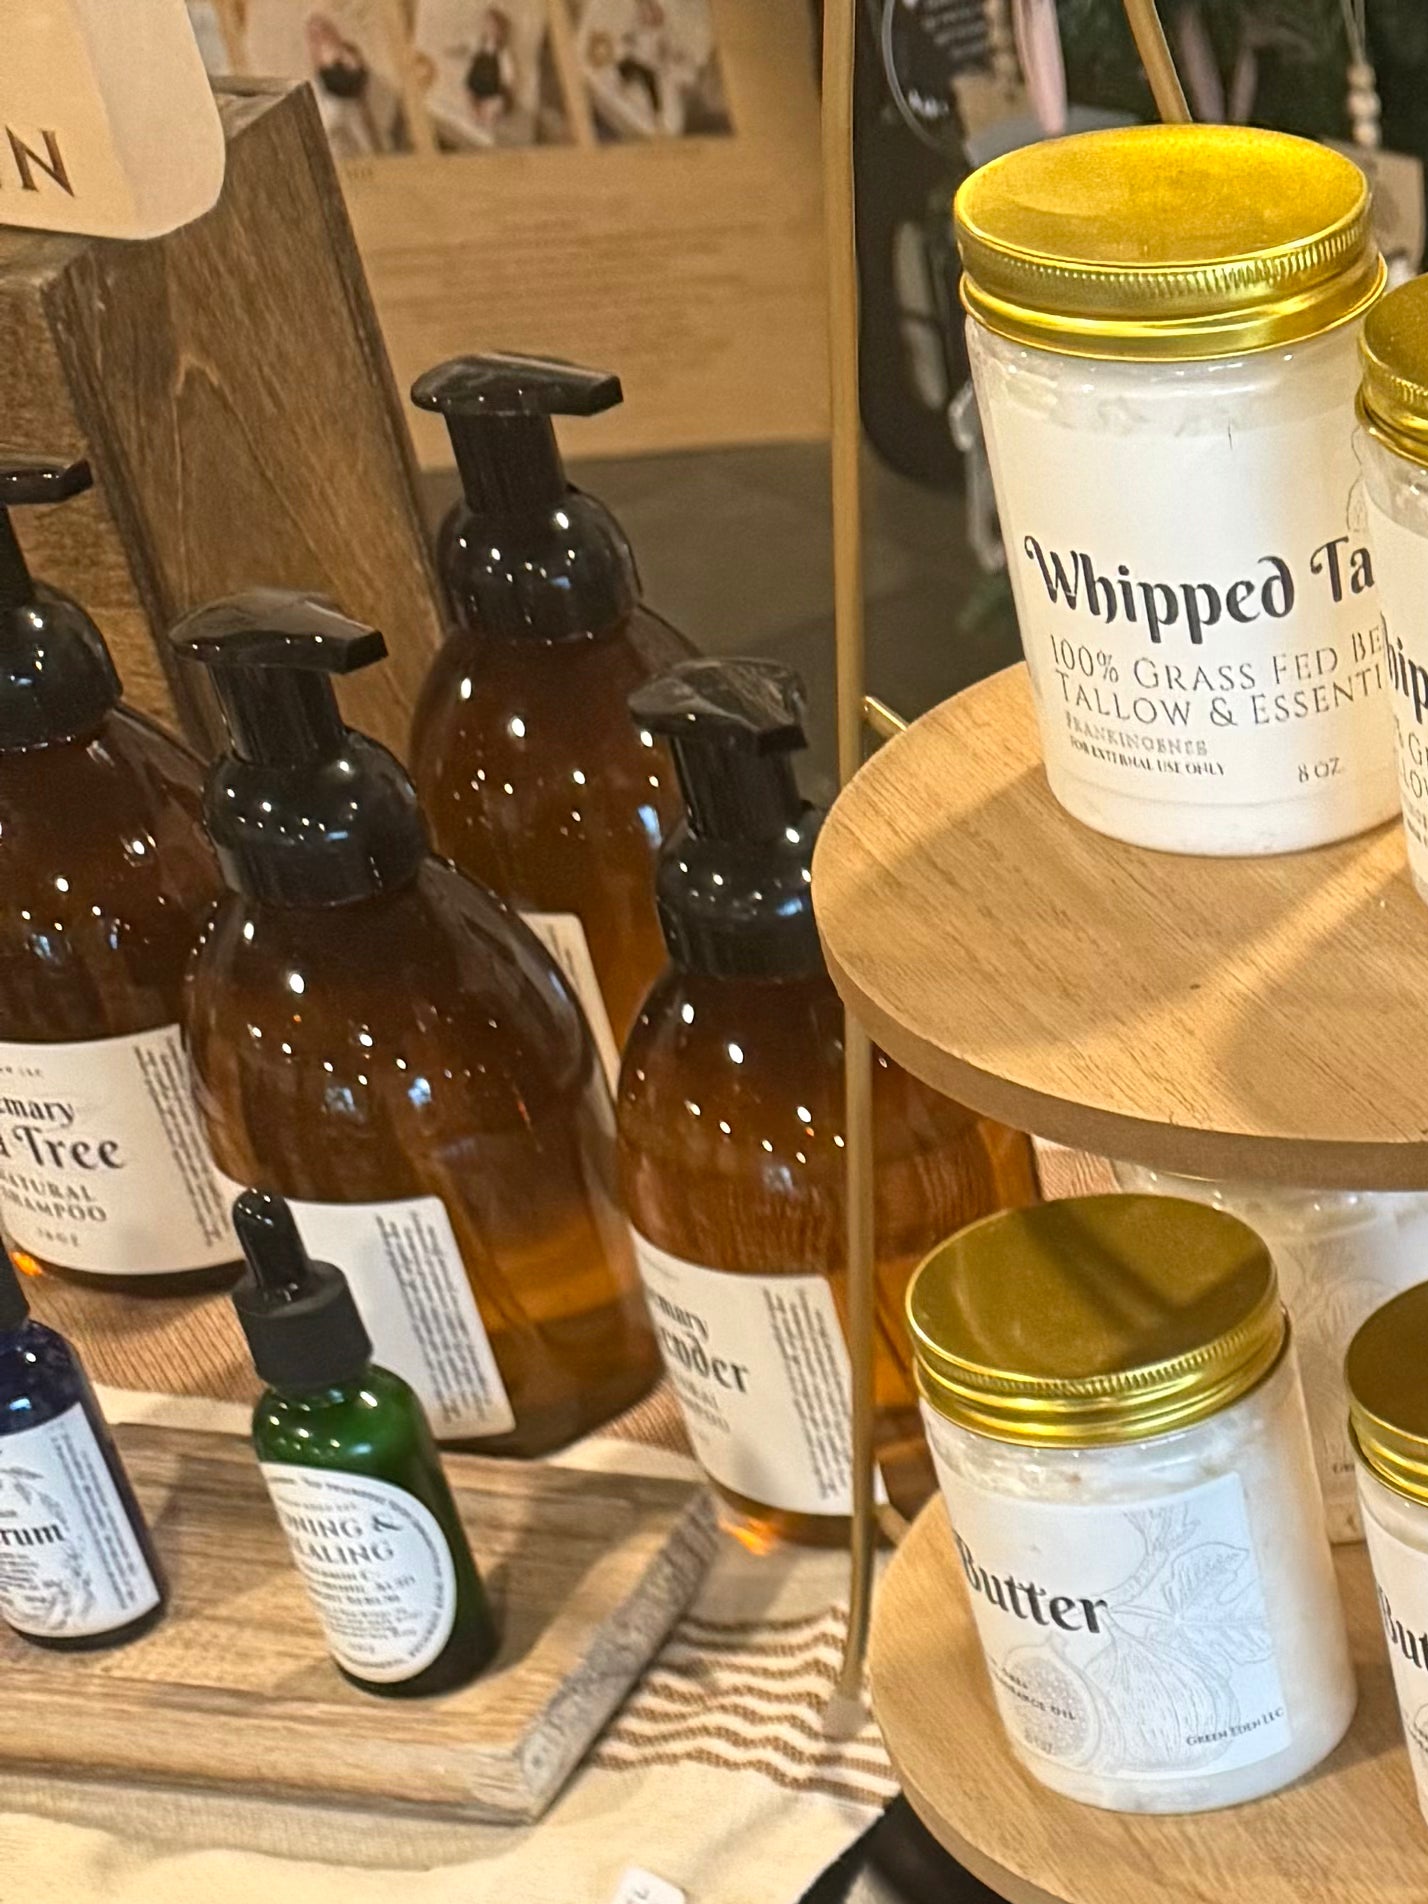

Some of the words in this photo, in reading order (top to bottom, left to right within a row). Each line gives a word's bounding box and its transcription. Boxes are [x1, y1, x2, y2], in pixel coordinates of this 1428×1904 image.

[1024, 535, 1295, 645] Whipped
[1310, 536, 1375, 602] Ta
[1050, 634, 1120, 684] 100%
[1133, 656, 1257, 692] GRASS
[1272, 646, 1339, 685] FED
[1351, 626, 1384, 660] BE
[1055, 667, 1191, 727] TALLOW
[1210, 696, 1238, 727] &
[1251, 663, 1385, 726] ESSENTI
[0, 1097, 75, 1128] mary
[12, 1125, 126, 1170] Tree
[0, 1523, 66, 1546] rum
[952, 1527, 1108, 1634] Butter
